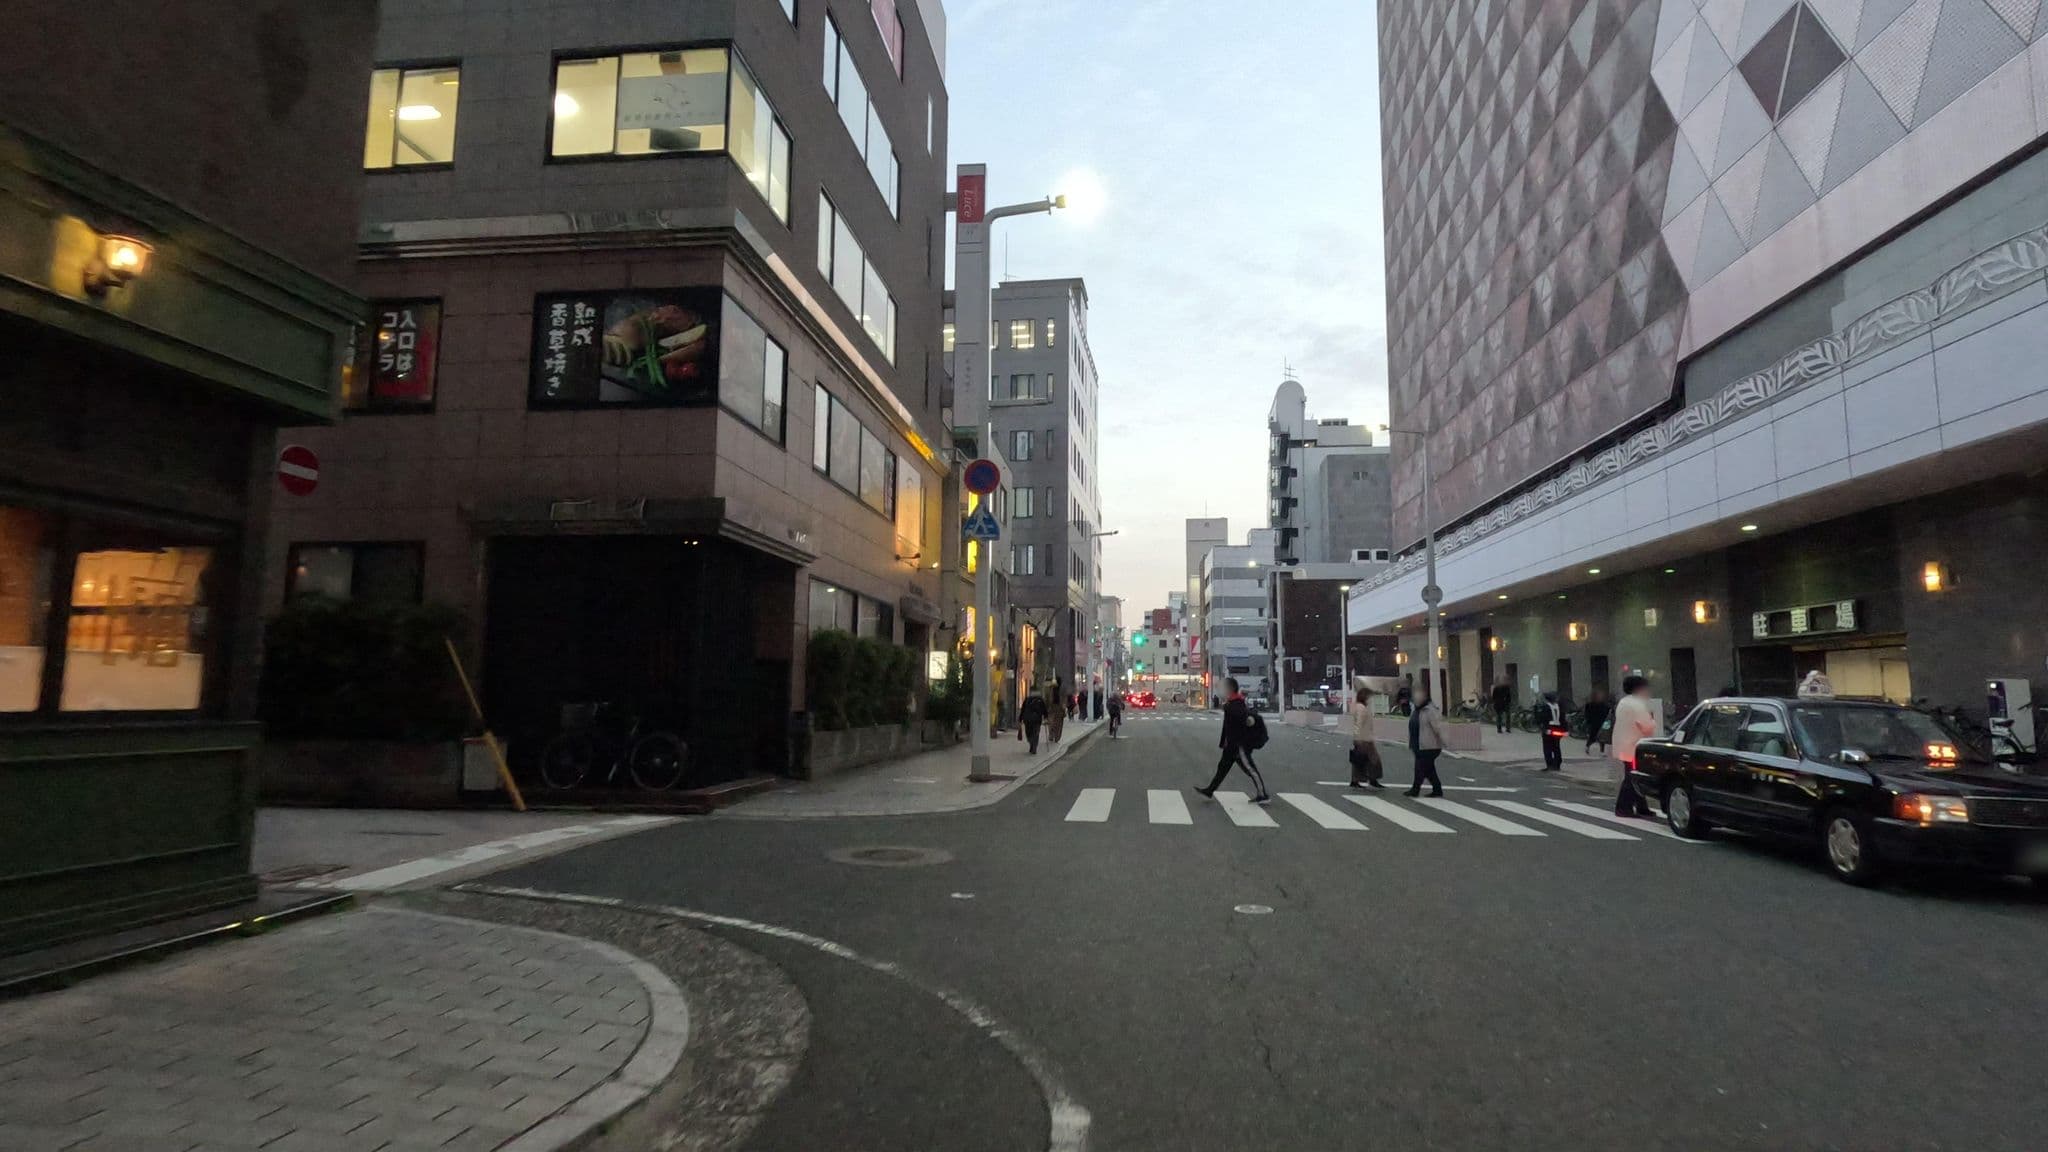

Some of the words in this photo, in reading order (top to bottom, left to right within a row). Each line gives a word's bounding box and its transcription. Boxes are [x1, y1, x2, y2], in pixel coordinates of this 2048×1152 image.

[379, 312, 398, 372] コチラ
[398, 310, 417, 372] 入口は
[544, 302, 568, 396] 香草焼き
[571, 301, 596, 346] 熟成
[1752, 601, 1854, 637] 駐車場
